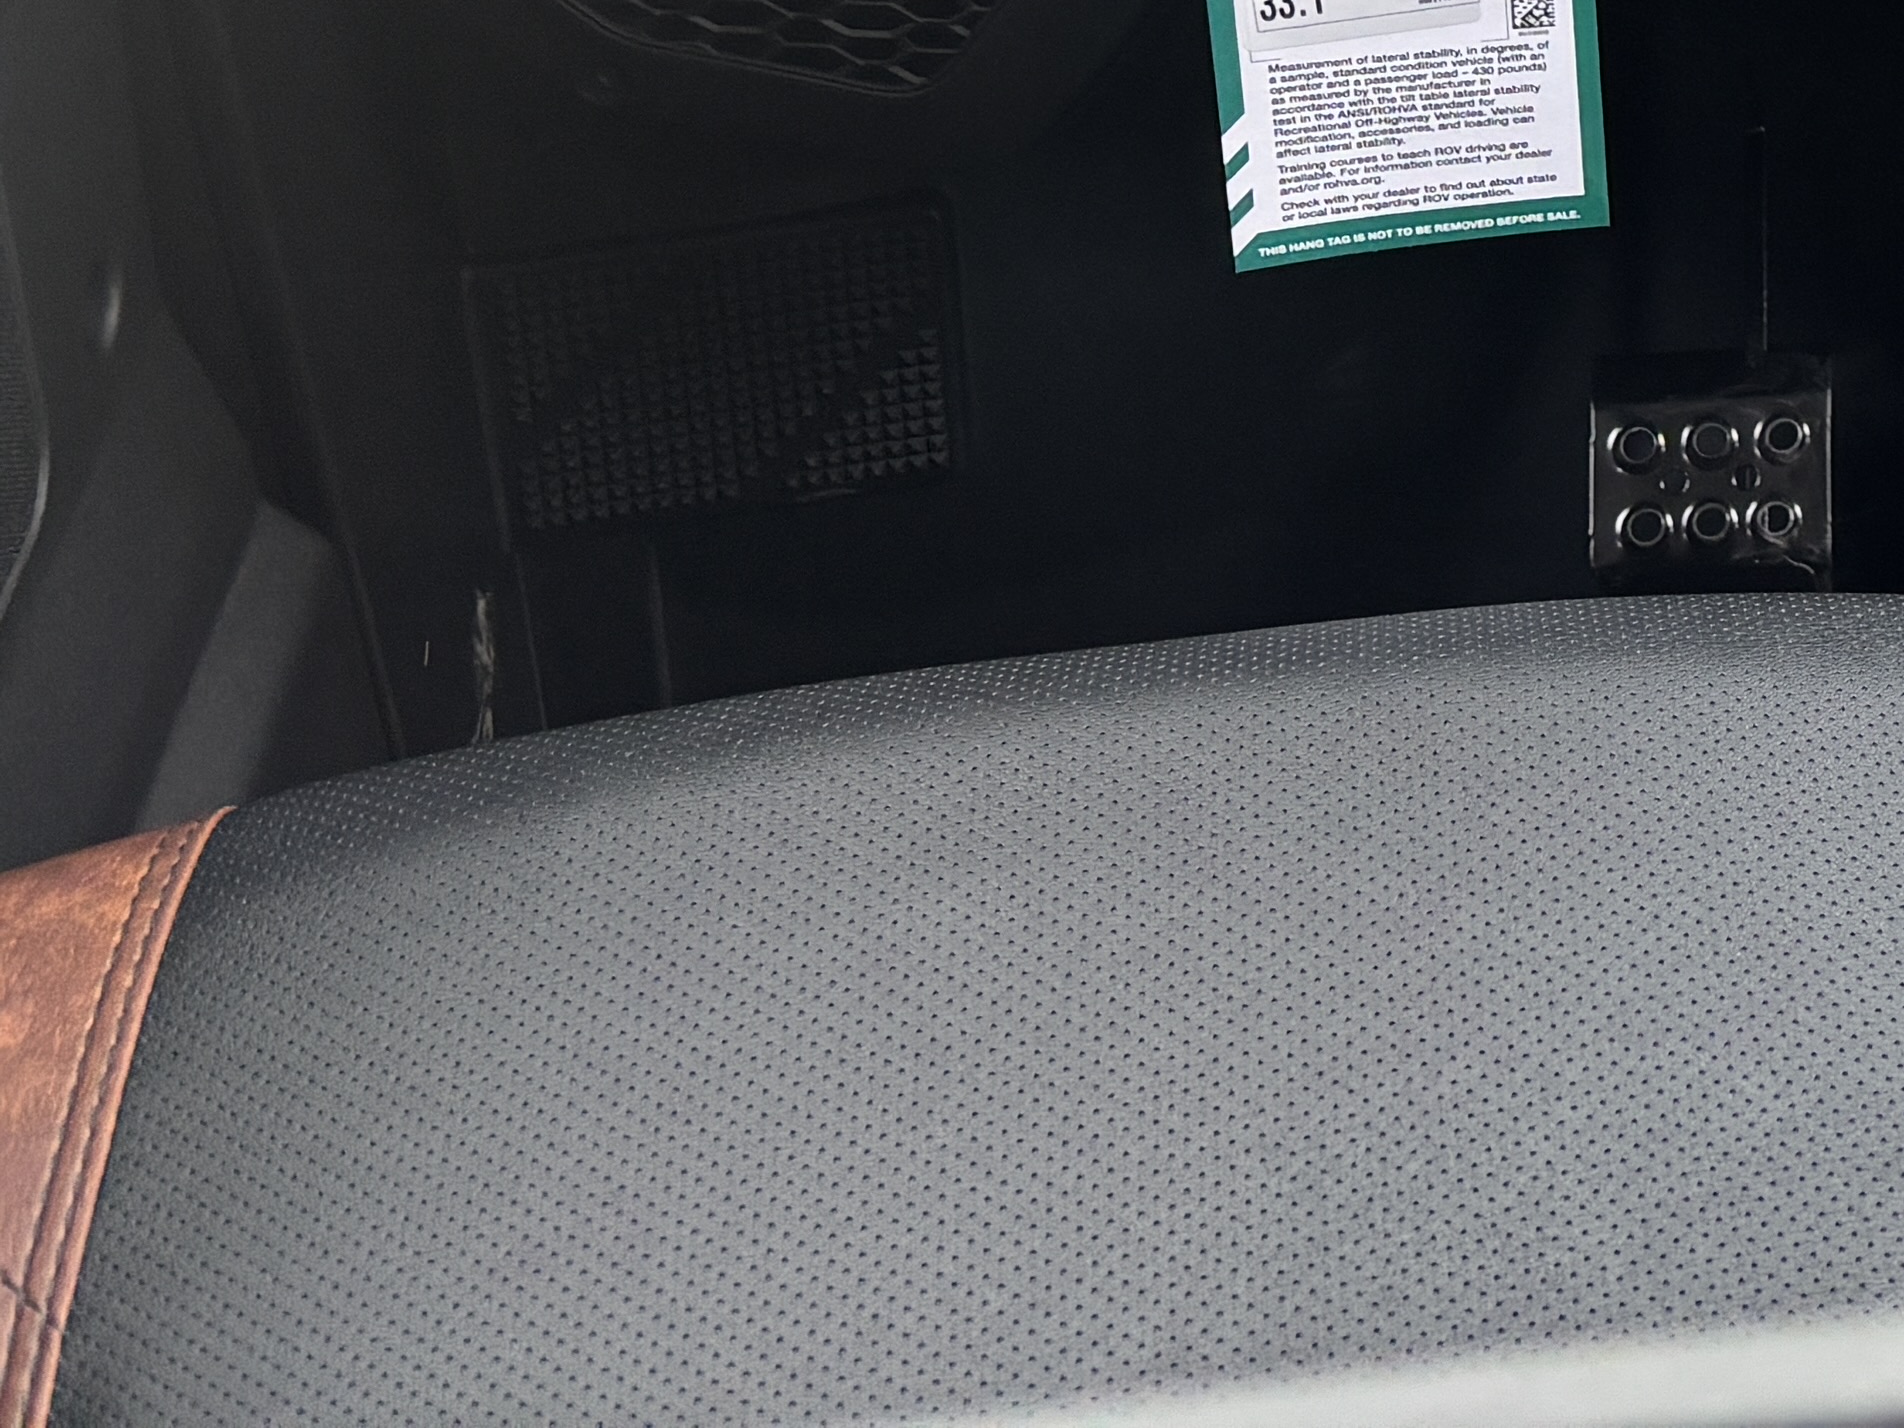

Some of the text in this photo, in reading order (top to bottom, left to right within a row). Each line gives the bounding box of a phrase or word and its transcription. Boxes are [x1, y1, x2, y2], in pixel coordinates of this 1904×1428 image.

[1268, 57, 1352, 73] Measurement
[1356, 56, 1368, 64] of
[1372, 52, 1409, 63] lateral
[1413, 49, 1462, 59] stability,
[1466, 47, 1477, 55] in
[1537, 40, 1549, 49] of
[1332, 65, 1387, 77] standard
[1390, 61, 1447, 72] condition
[1451, 56, 1493, 67] vehicle
[1497, 53, 1526, 64] (with
[1270, 82, 1323, 95] operator
[1327, 79, 1349, 88] and
[1364, 73, 1428, 87] passenger
[1432, 69, 1458, 79] load
[1498, 62, 1546, 75] pounds)
[1289, 89, 1350, 103] measured
[1354, 88, 1368, 97] by
[1395, 80, 1476, 93] manufacturer
[1272, 102, 1344, 116] accordance
[1348, 98, 1373, 107] with
[1377, 96, 1397, 104] the
[1419, 92, 1449, 101] table
[1453, 87, 1490, 98] lateral
[1494, 84, 1540, 95] stability
[1273, 116, 1296, 126] test
[1314, 113, 1334, 121] the
[1421, 99, 1475, 111] standard
[1479, 98, 1495, 106] for
[1274, 120, 1351, 137] Recreational
[1355, 115, 1430, 128] Off-Highway
[1491, 105, 1534, 116] Vehicle
[1275, 133, 1355, 147] modification,
[1438, 121, 1460, 130] and
[1464, 118, 1509, 128] loading
[1512, 116, 1534, 124] can
[1276, 147, 1310, 158] affect
[1314, 141, 1352, 153] lateral
[1277, 162, 1326, 174] Training
[1329, 156, 1378, 167] courses
[1381, 153, 1393, 161] to
[1397, 149, 1430, 159] teach
[1435, 146, 1461, 156] ROV
[1465, 143, 1506, 153] driving
[1340, 168, 1359, 176] For
[1364, 160, 1432, 173] information
[1436, 154, 1481, 166] contact
[1485, 153, 1512, 163] your
[1515, 149, 1552, 159] dealer
[1280, 183, 1320, 195] and/or
[1281, 174, 1557, 211] Check with your dealer to find out about state
[1298, 207, 1327, 219] local
[1331, 205, 1358, 214] laws
[1362, 198, 1419, 211] regarding
[1423, 194, 1449, 203] ROV
[1258, 245, 1286, 256] THIS
[1289, 239, 1324, 252] HANG
[1327, 235, 1351, 246] TAG
[1353, 233, 1365, 242] IS
[1368, 229, 1393, 240] NOT
[1396, 227, 1413, 236] TO
[1415, 225, 1431, 235] BE
[1434, 218, 1494, 232] REMOVED
[1496, 213, 1544, 226] BEFORE
